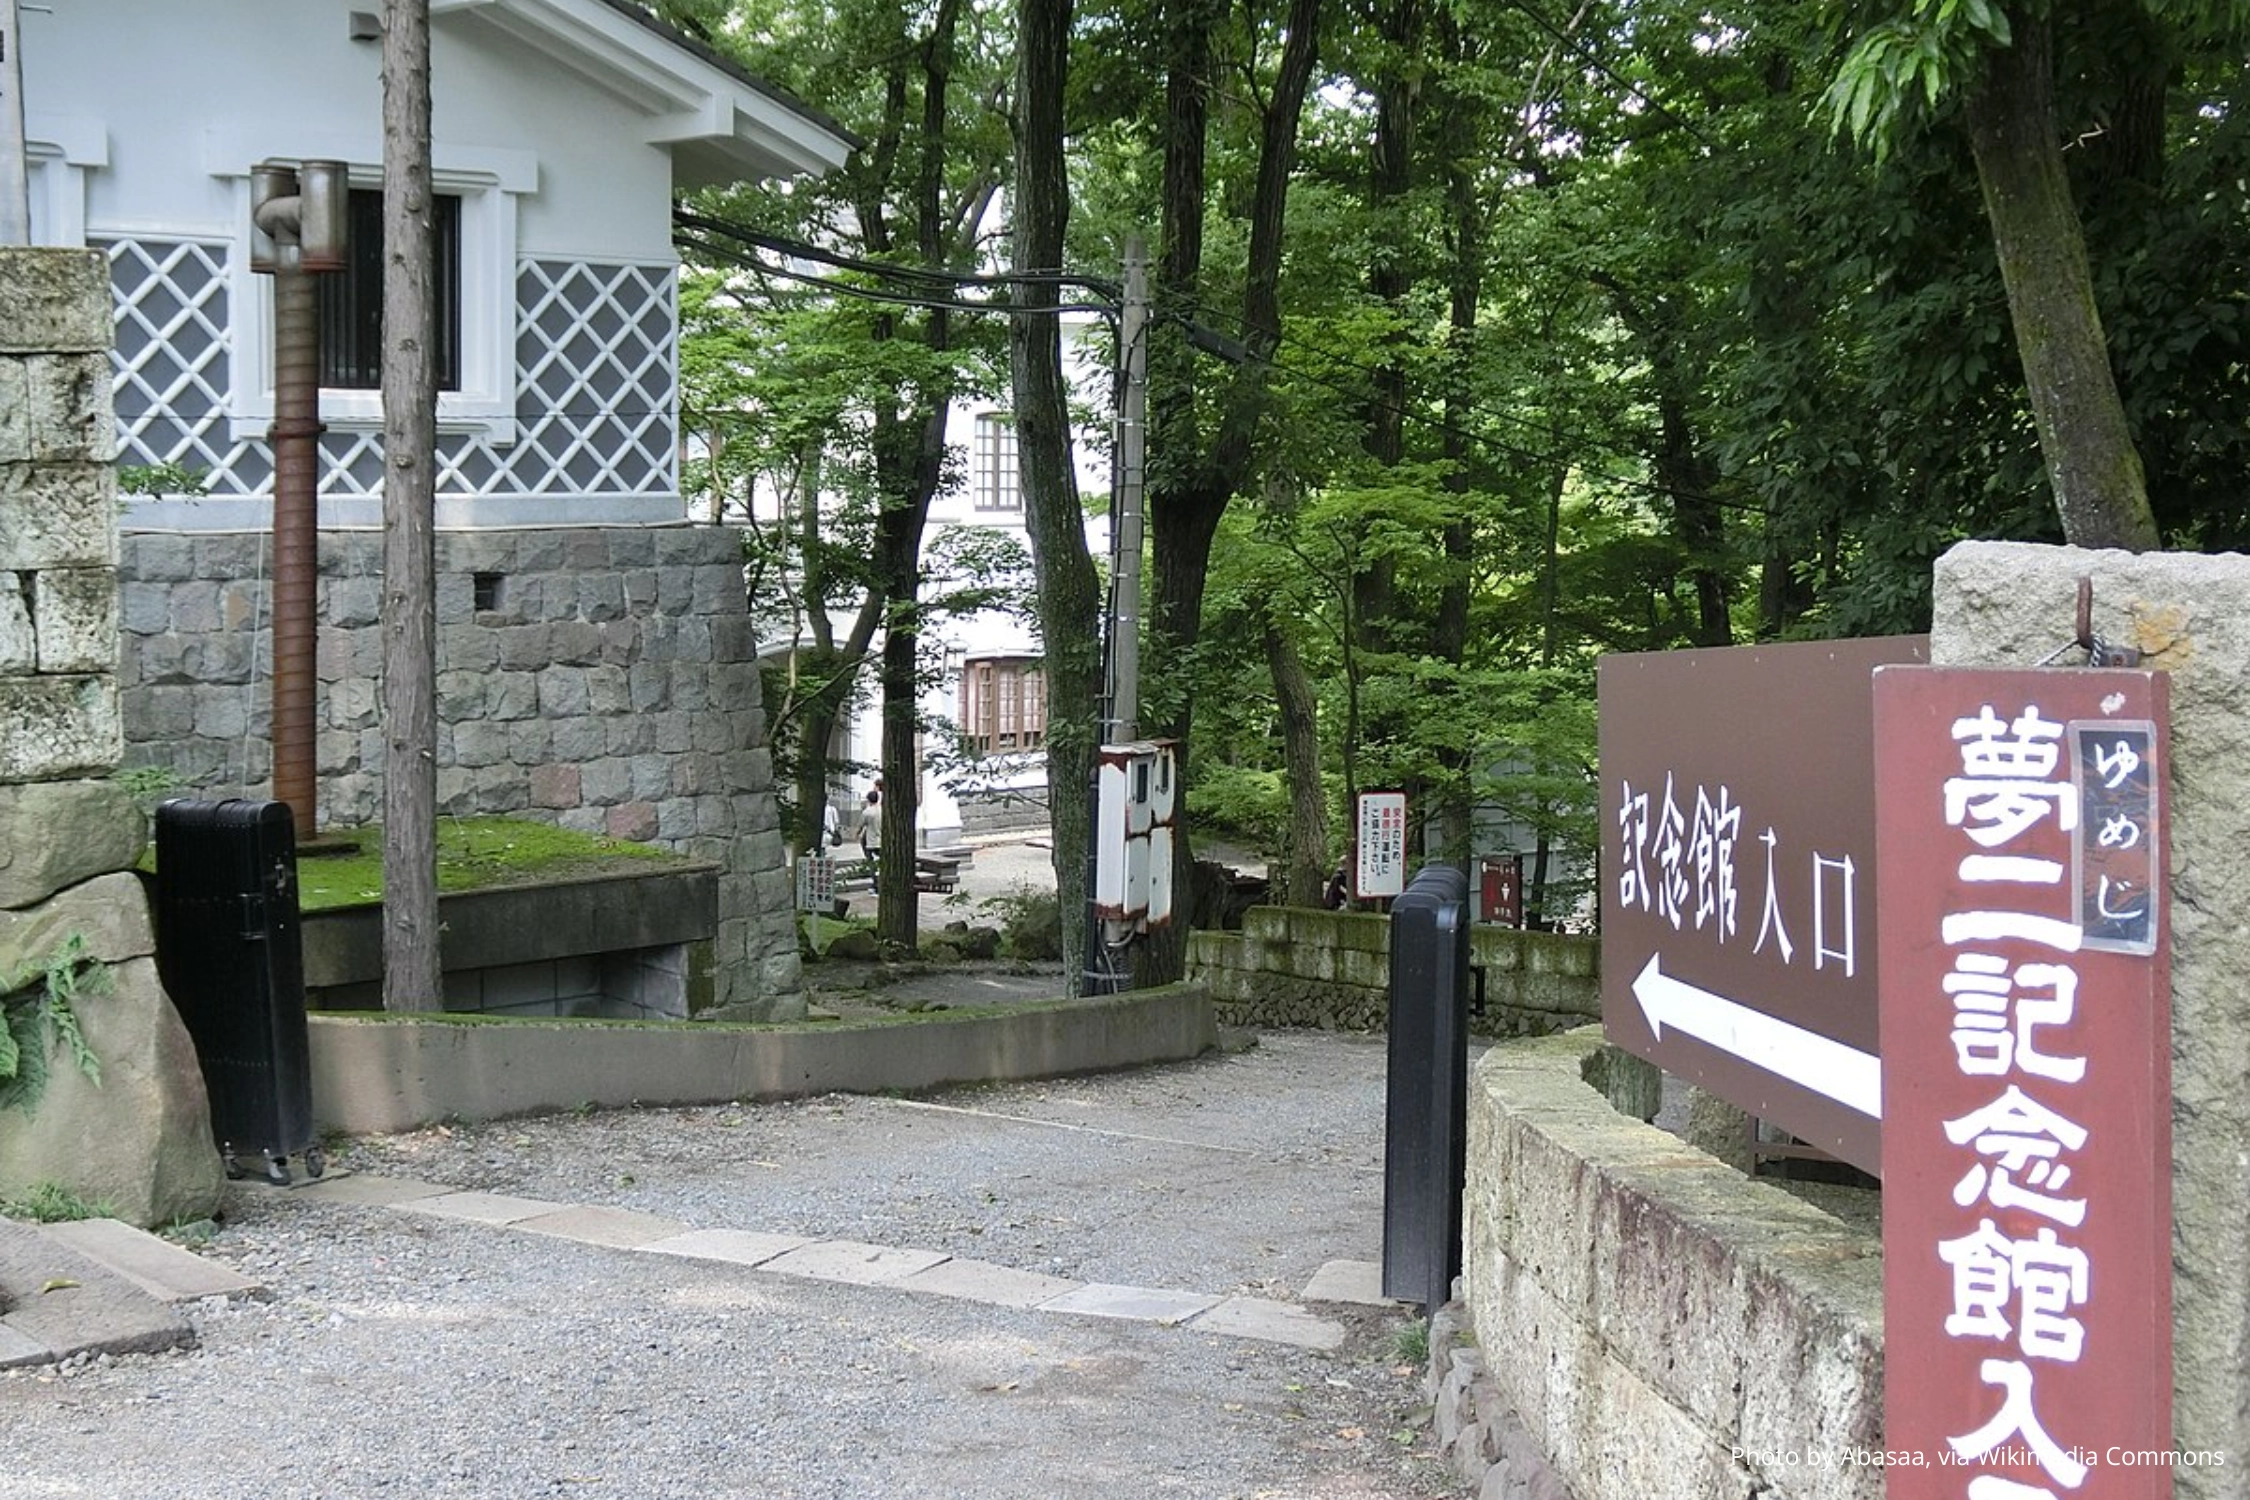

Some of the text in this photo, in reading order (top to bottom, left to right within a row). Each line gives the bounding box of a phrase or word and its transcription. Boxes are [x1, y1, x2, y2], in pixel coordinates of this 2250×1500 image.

[1619, 769, 1856, 978] 記念館入口
[2094, 739, 2144, 920] ゆめじ
[1939, 704, 2091, 1500] 夢二記念館入
